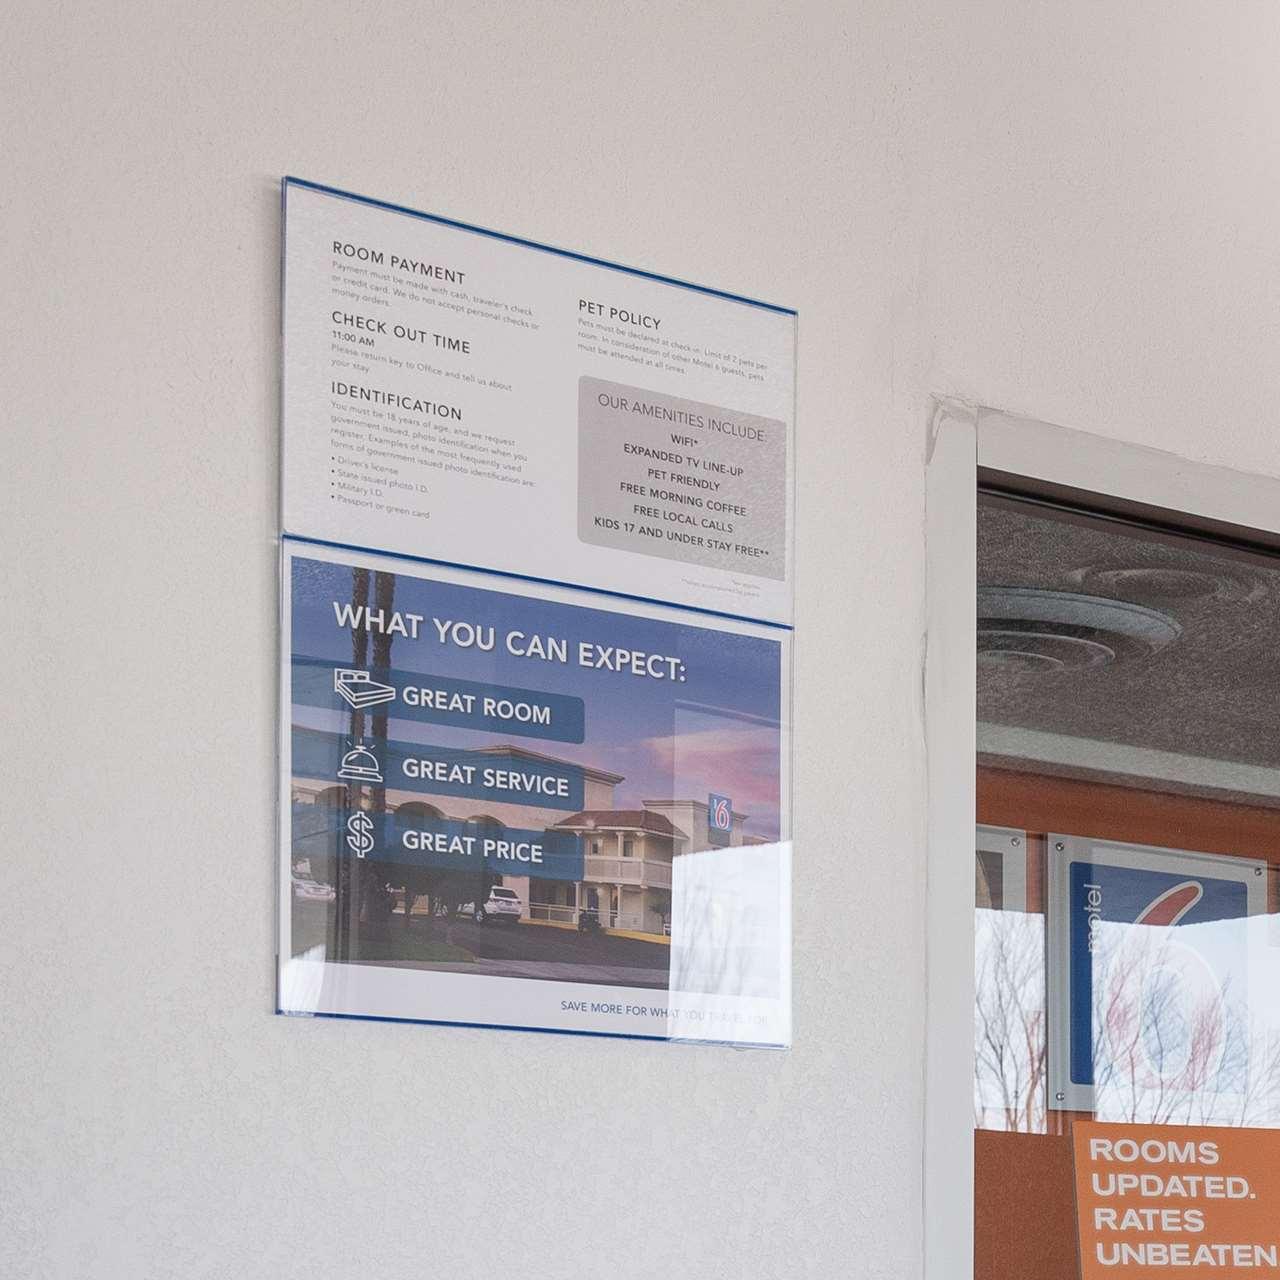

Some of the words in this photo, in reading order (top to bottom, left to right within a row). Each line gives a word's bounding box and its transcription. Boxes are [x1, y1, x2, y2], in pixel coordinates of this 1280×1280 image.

[332, 261, 368, 276] Payment
[333, 241, 384, 265] ROOM
[391, 255, 466, 285] PAYMENT
[343, 278, 368, 289] credit
[392, 288, 406, 298] We
[408, 292, 420, 302] do
[422, 296, 435, 306] not
[466, 307, 501, 321] personal
[579, 299, 605, 316] PET
[610, 307, 661, 330] POLICY
[332, 311, 387, 335] CHECK
[393, 325, 427, 344] OUT
[433, 334, 470, 354] TIME
[332, 330, 356, 343] 11:00
[359, 336, 375, 348] AM
[331, 343, 359, 357] Please
[361, 351, 387, 363] return
[389, 356, 403, 369] key
[406, 361, 415, 370] to
[445, 371, 460, 380] and
[489, 380, 513, 392] about
[332, 381, 462, 421] IDENTIFICATION
[598, 393, 629, 411] OUR
[632, 401, 704, 429] AMENITIES
[708, 417, 768, 443] INCLUDE:
[624, 443, 683, 464] EXPANDED
[686, 457, 700, 469] TV
[703, 460, 744, 477] LINE-UP
[337, 469, 359, 479] State
[389, 480, 413, 491] photo
[648, 468, 667, 480] PET
[670, 473, 720, 492] FRIENDLY
[337, 494, 373, 509] Passport
[386, 505, 410, 516] green
[412, 511, 430, 519] card
[620, 482, 646, 496] FREE
[650, 488, 703, 508] MORNING
[706, 500, 747, 517] COFFEE
[594, 516, 620, 530] KIDS
[624, 522, 635, 533] 17
[639, 526, 663, 538] AND
[666, 530, 704, 547] UNDER
[707, 539, 732, 552] STAY
[634, 504, 660, 519] FREE
[663, 511, 698, 526] LOCAL
[701, 519, 734, 534] CALLS
[333, 601, 424, 639] WHAT
[433, 617, 495, 651] YOU
[506, 631, 568, 663] CAN
[579, 642, 687, 682] EXPECT:
[403, 686, 476, 714] GREAT
[483, 698, 551, 725] ROOM
[402, 758, 476, 785] GREAT
[483, 768, 569, 797] SERVICE
[402, 830, 476, 856] GREAT
[483, 839, 543, 864] PRICE
[561, 1001, 587, 1012] SAVE
[590, 1002, 623, 1014] MORE
[626, 1005, 648, 1017] FOR
[650, 1008, 680, 1019] WHAT
[1089, 1138, 1220, 1166] ROOMS
[1092, 1174, 1256, 1199] UPDATED.
[1094, 1207, 1205, 1233] RATES
